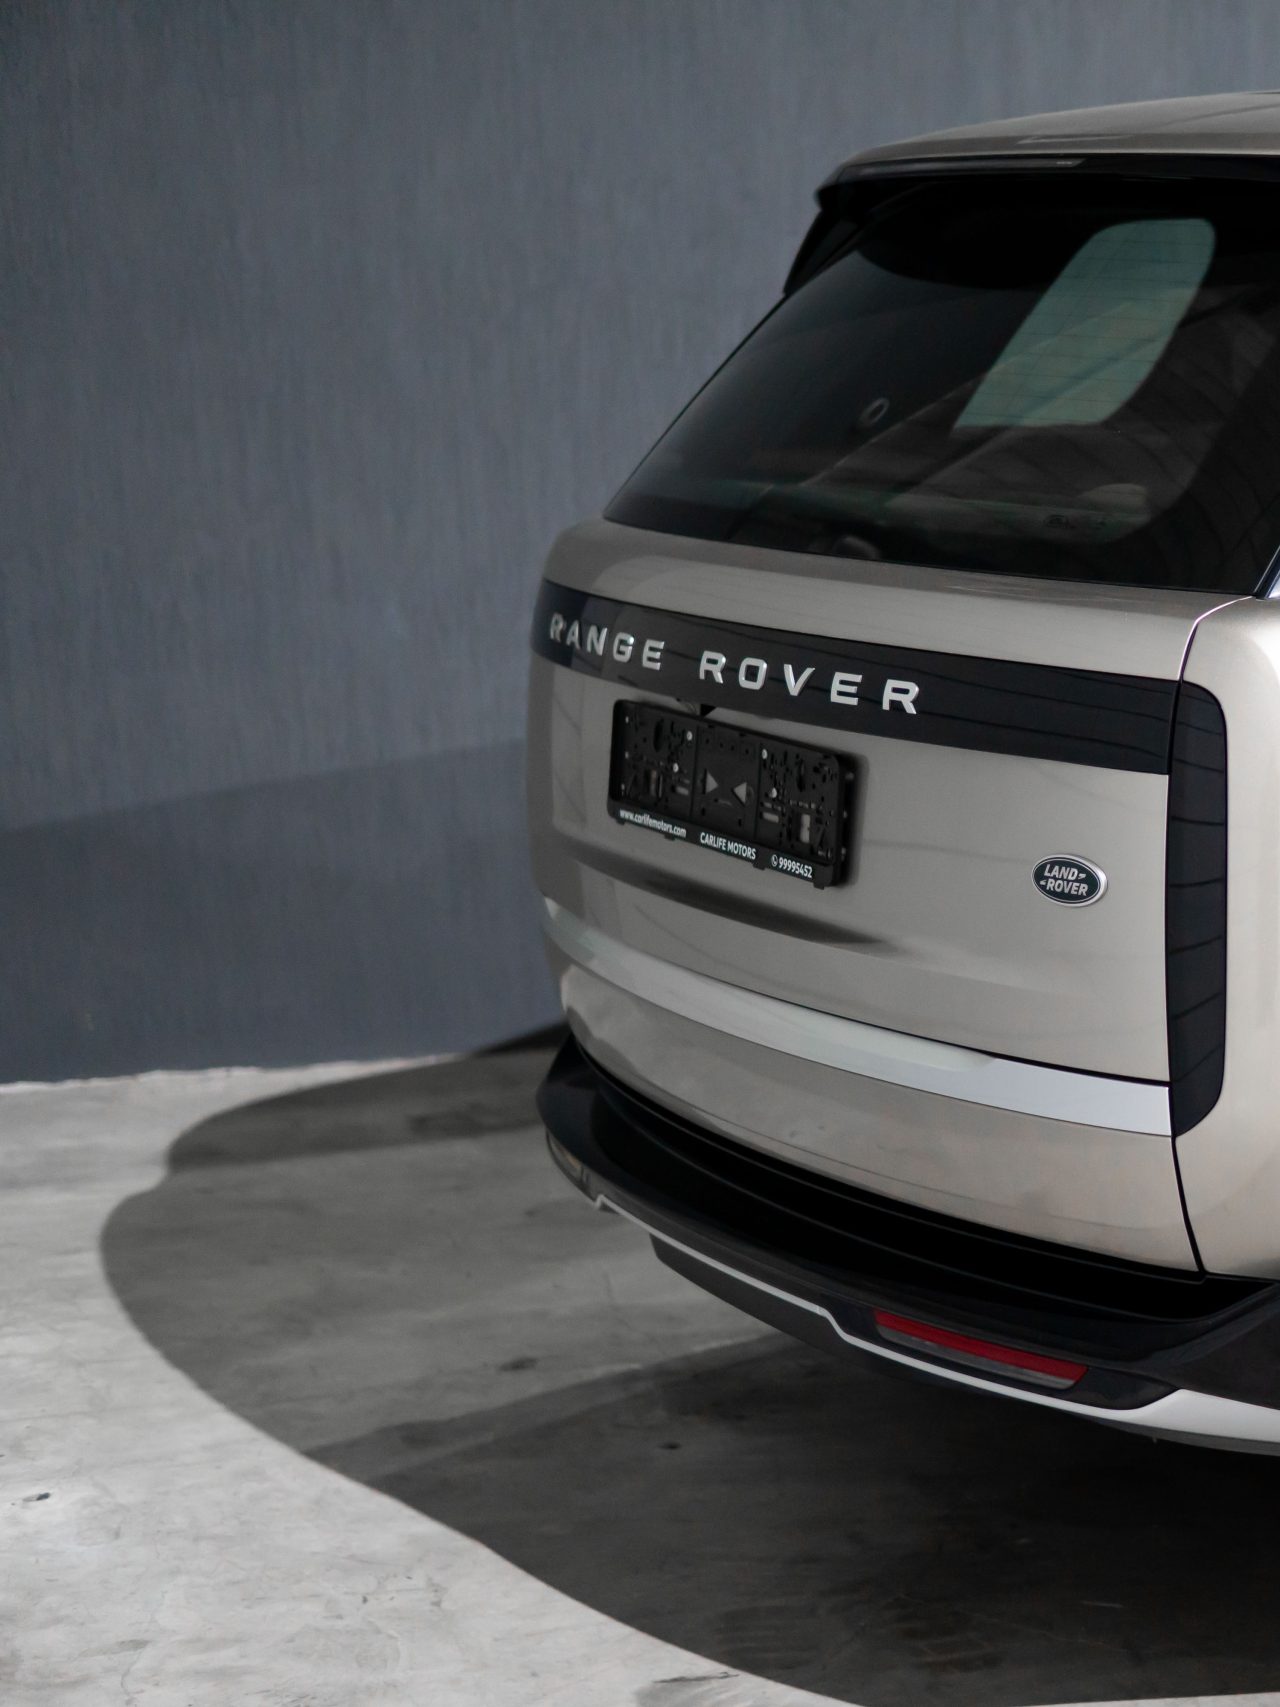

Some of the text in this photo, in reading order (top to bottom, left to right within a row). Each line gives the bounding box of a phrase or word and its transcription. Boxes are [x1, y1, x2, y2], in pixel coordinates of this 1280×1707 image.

[549, 612, 920, 715] RANGE ROVER
[619, 809, 687, 838] www.carlifemotors.com
[700, 832, 756, 860] CARLIFE MOTORS
[779, 857, 813, 878] 99995452
[1044, 863, 1079, 881] LAND
[1046, 878, 1089, 896] ROVER
